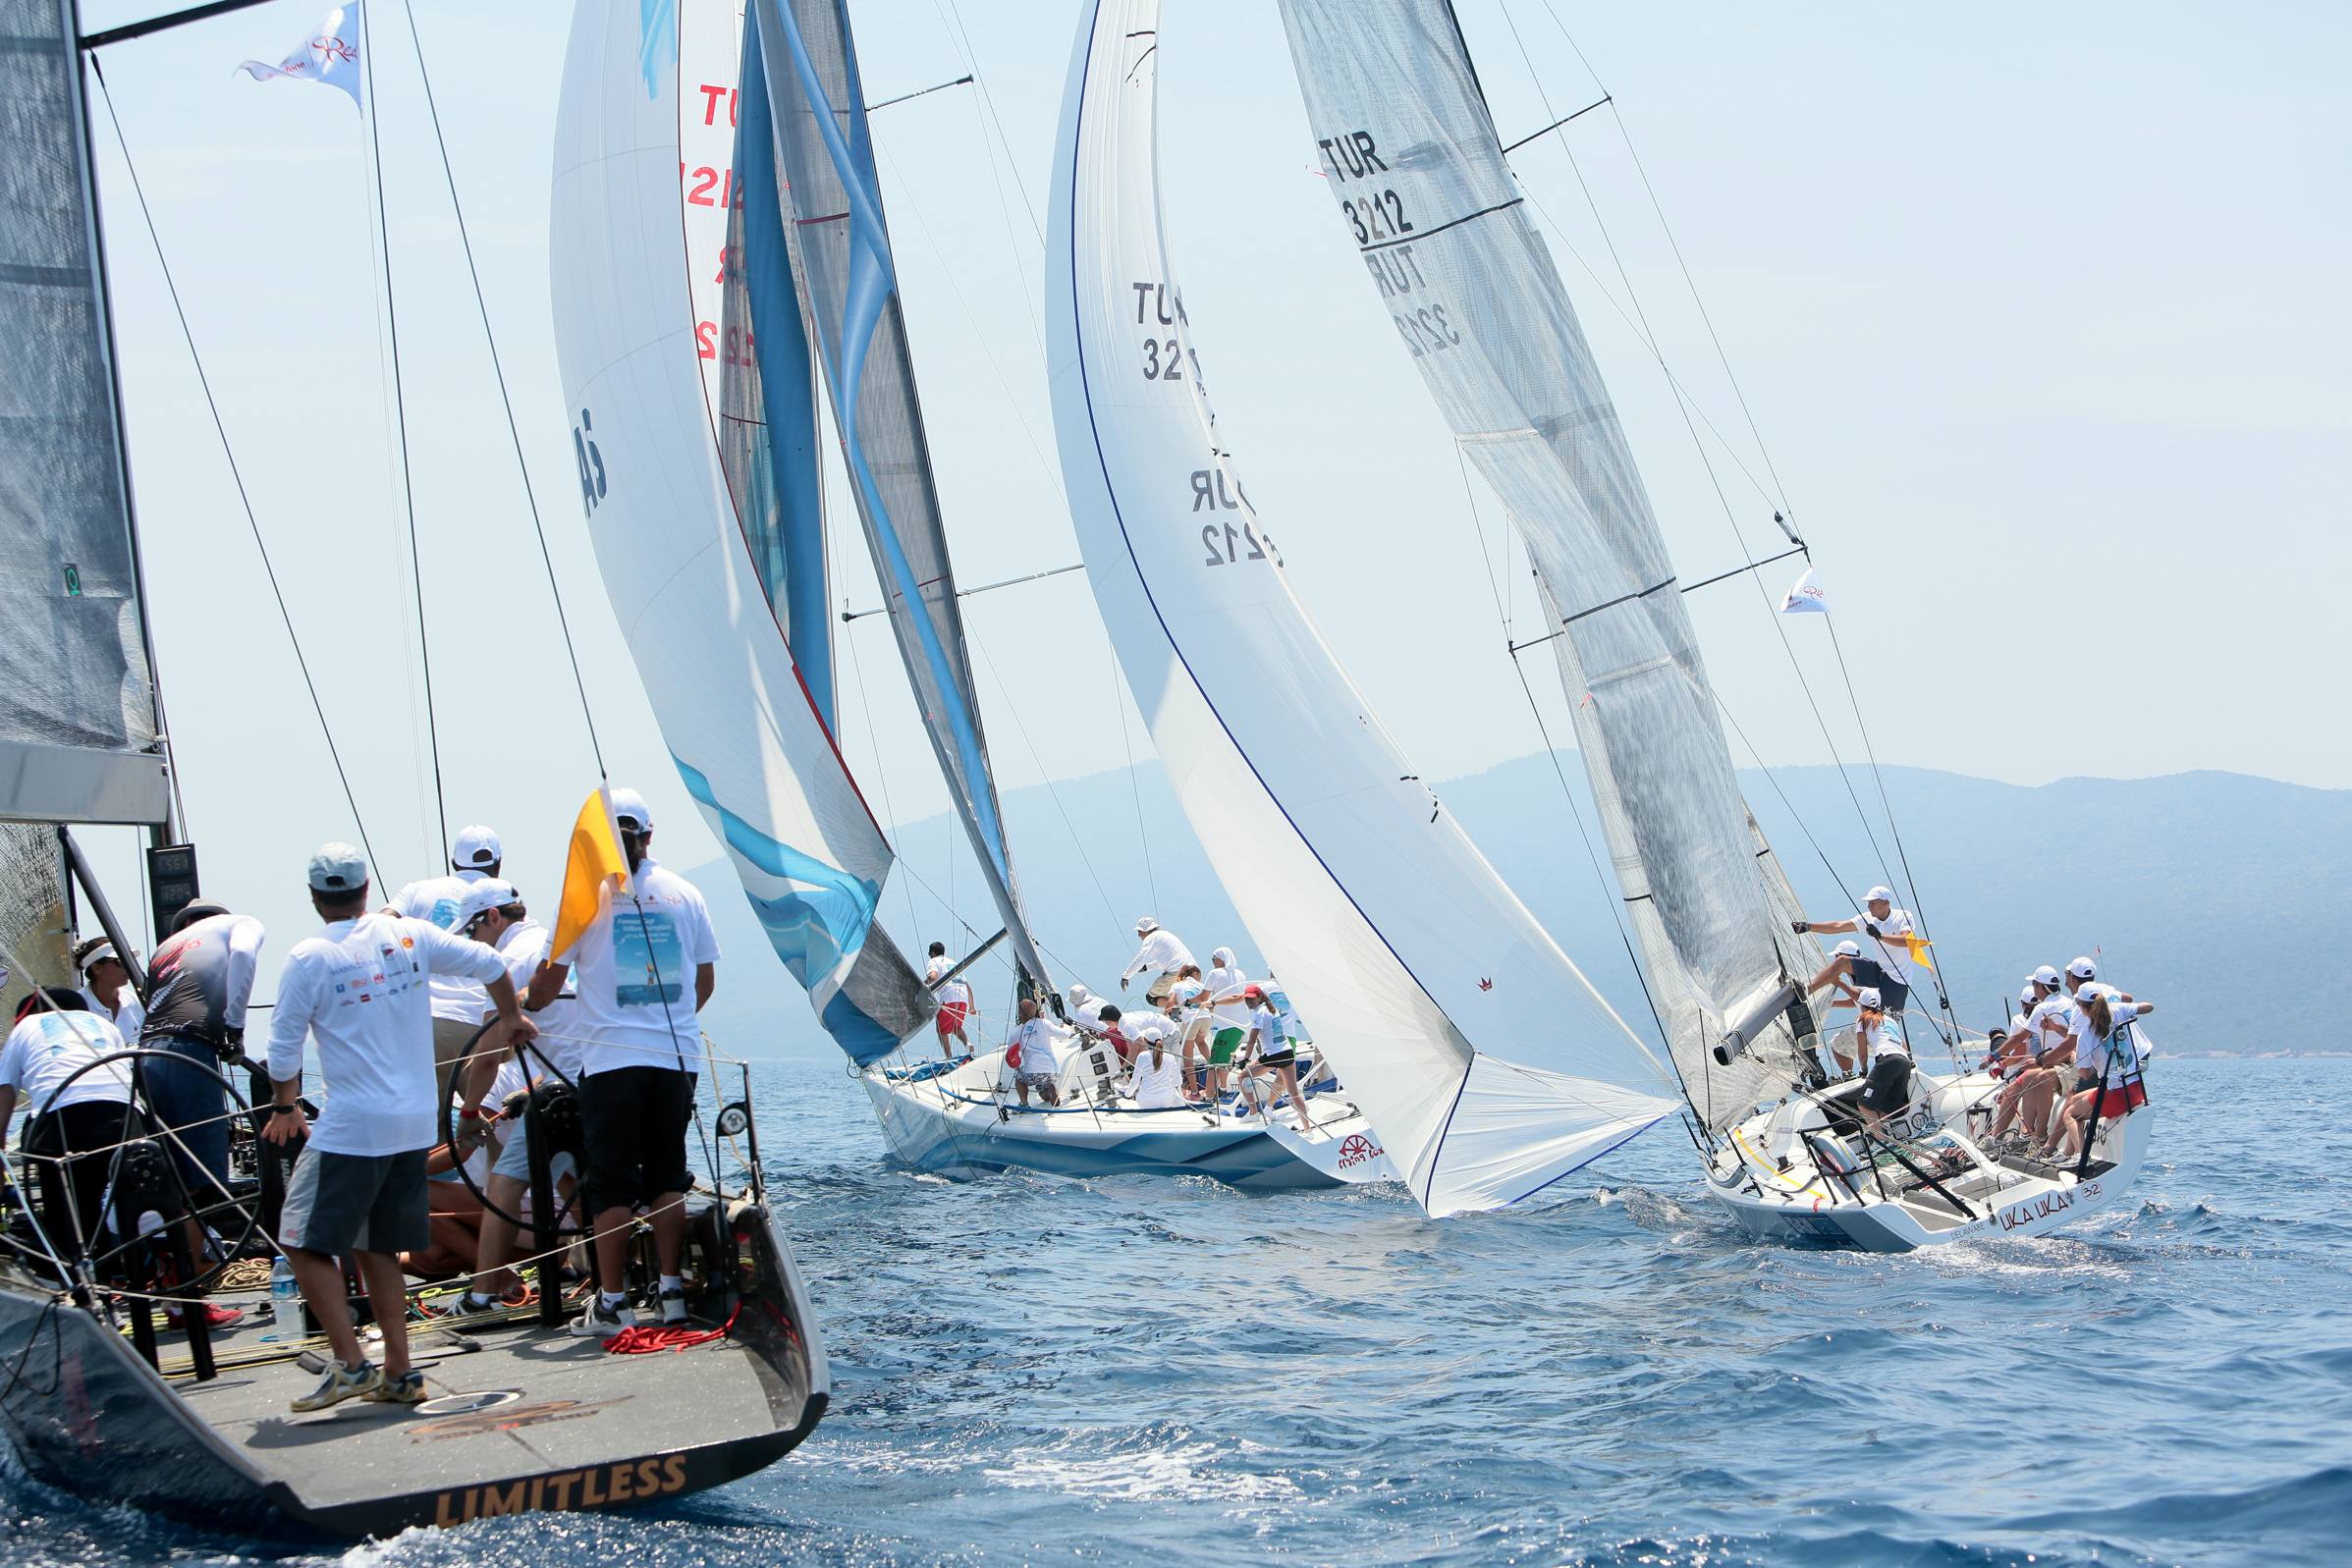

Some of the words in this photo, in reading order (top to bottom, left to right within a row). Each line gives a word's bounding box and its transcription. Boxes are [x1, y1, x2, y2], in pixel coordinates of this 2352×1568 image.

[1318, 131, 1389, 183] TUR
[1342, 189, 1414, 244] 3212
[1998, 1206, 2035, 1232] UKA
[2034, 1193, 2069, 1218] UKA
[2082, 1183, 2103, 1198] 32
[435, 1454, 687, 1530] LIMITLESS
